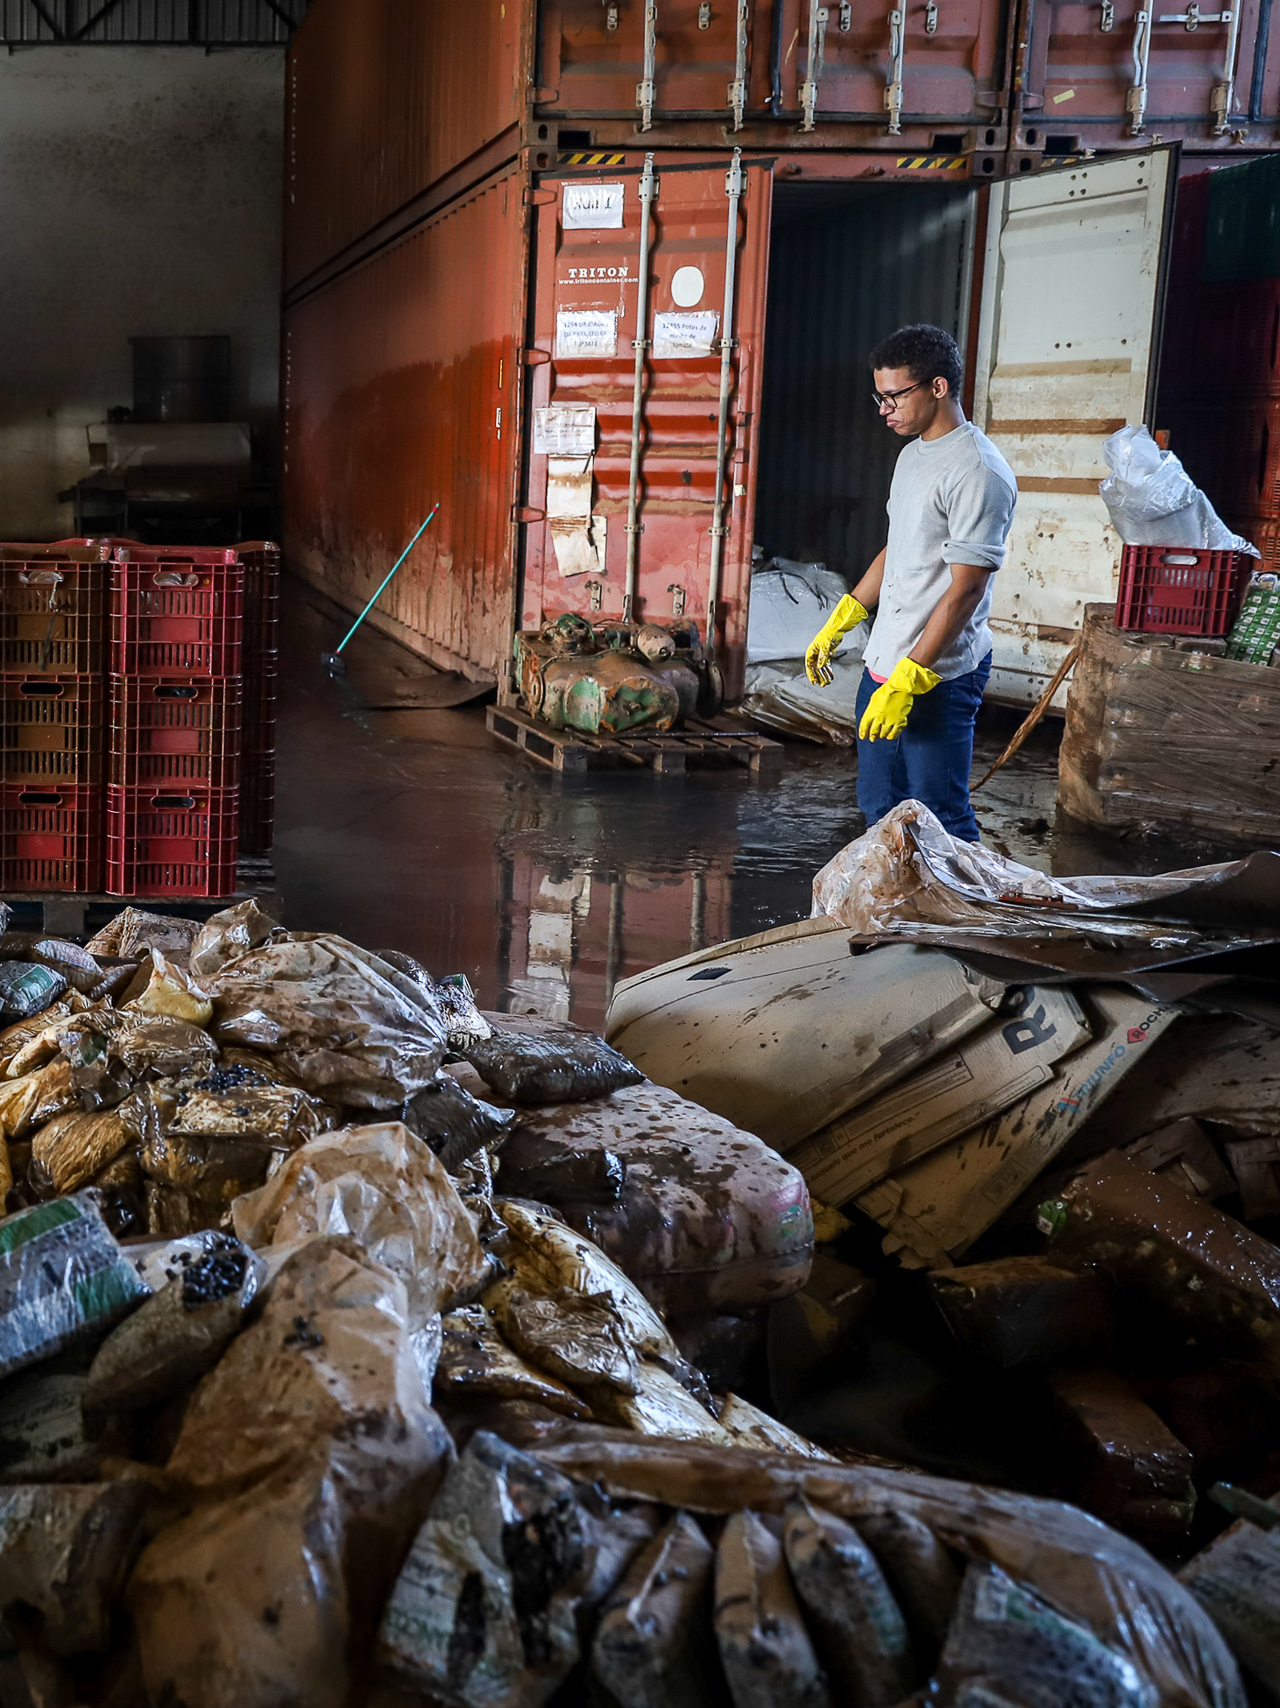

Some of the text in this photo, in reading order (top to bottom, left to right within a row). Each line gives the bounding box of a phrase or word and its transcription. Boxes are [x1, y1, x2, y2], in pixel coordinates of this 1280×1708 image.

[568, 266, 630, 279] TRITON
[558, 277, 639, 285] www.tritoncontainer.com
[1131, 1004, 1171, 1040] ROCH
[1073, 1044, 1126, 1102] TRIUNFO
[842, 1146, 859, 1162] que
